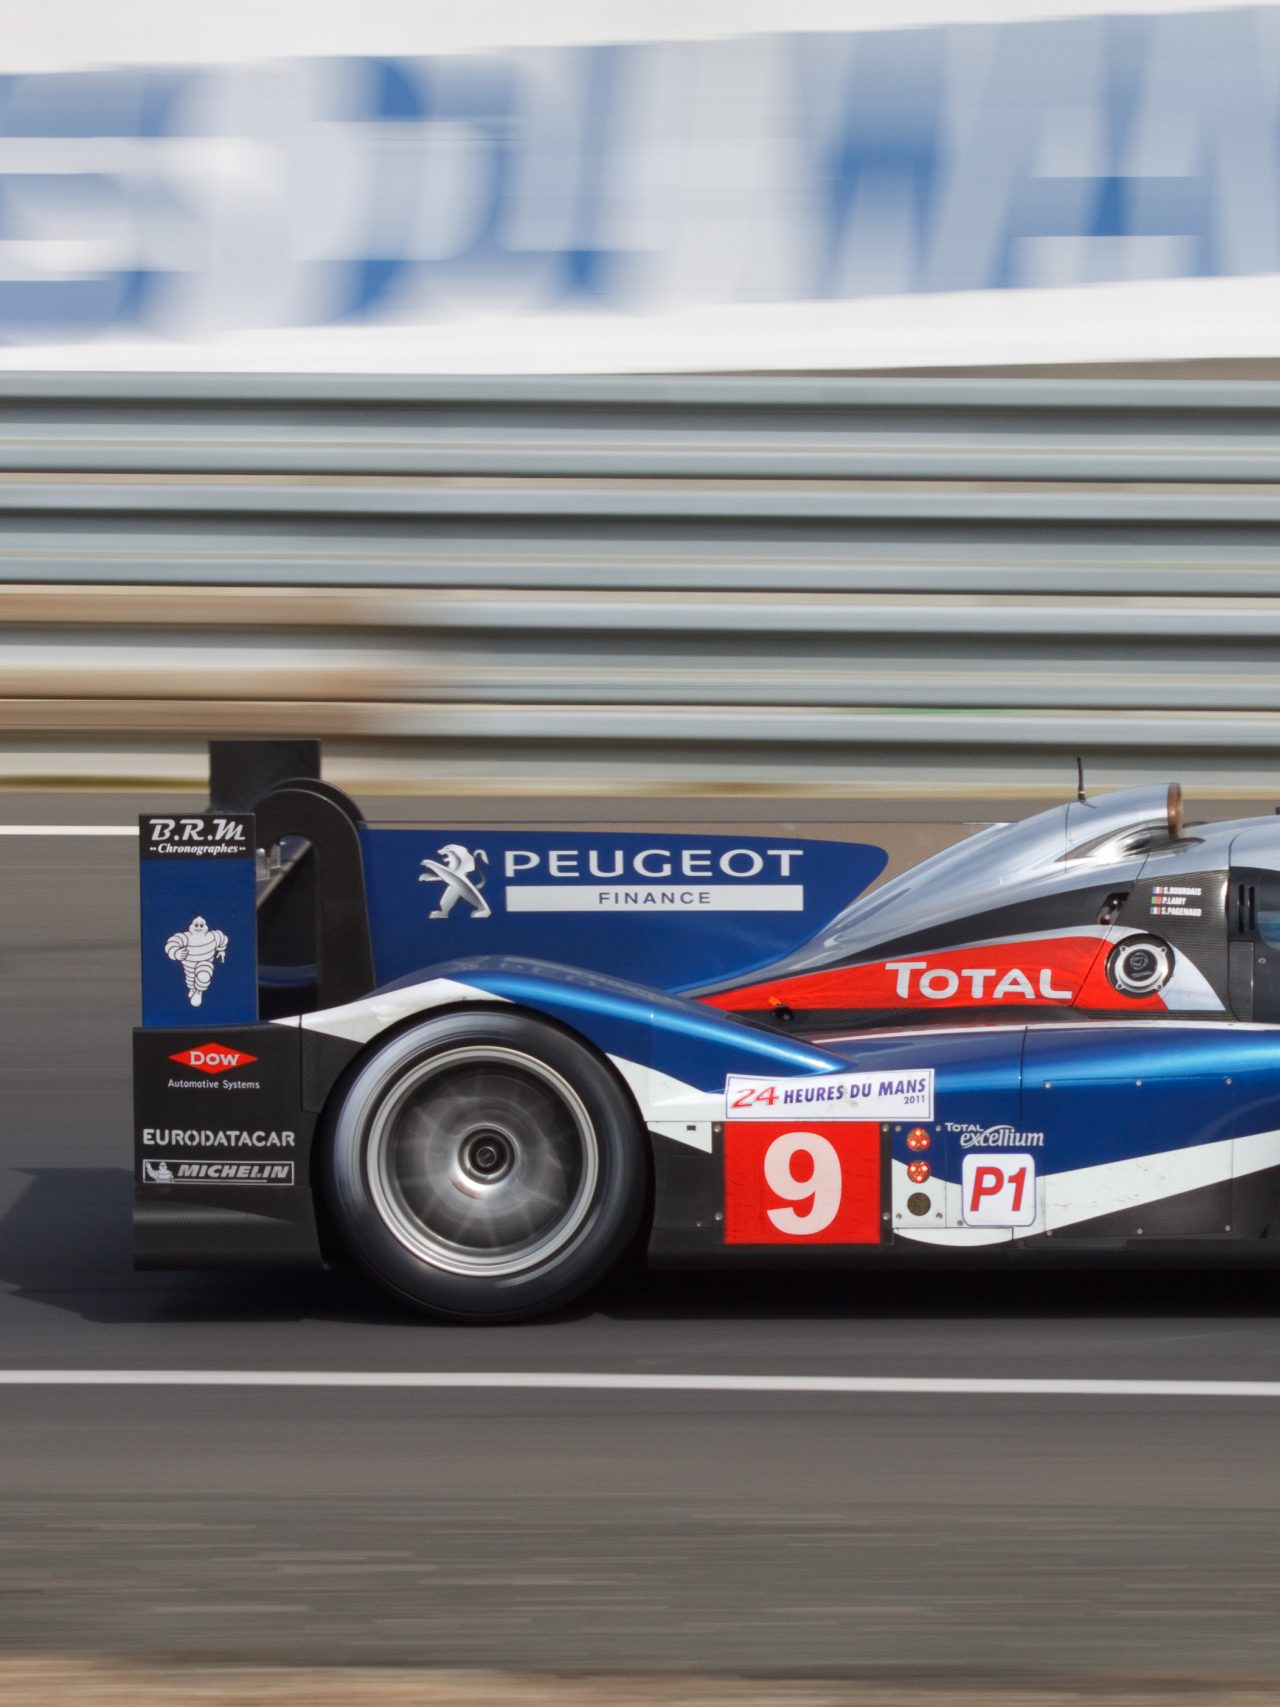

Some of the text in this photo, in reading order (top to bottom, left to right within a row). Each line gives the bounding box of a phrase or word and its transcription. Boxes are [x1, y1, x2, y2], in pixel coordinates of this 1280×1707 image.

[157, 842, 239, 855] Chronographes
[504, 849, 804, 878] PEUGEOT
[598, 891, 711, 905] FINANCE
[885, 961, 1073, 999] TOTAL
[167, 1078, 260, 1091] Automotive Systems
[732, 1078, 926, 1109] 24 HEURES DU MANS
[903, 1094, 926, 1105] 2011
[944, 1122, 984, 1133] TOTAL
[959, 1125, 1045, 1149] excellium
[142, 1128, 295, 1147] EURODATACAR
[177, 1164, 290, 1178] MICHELIN
[763, 1131, 843, 1236] 9
[969, 1166, 1027, 1212] P1
